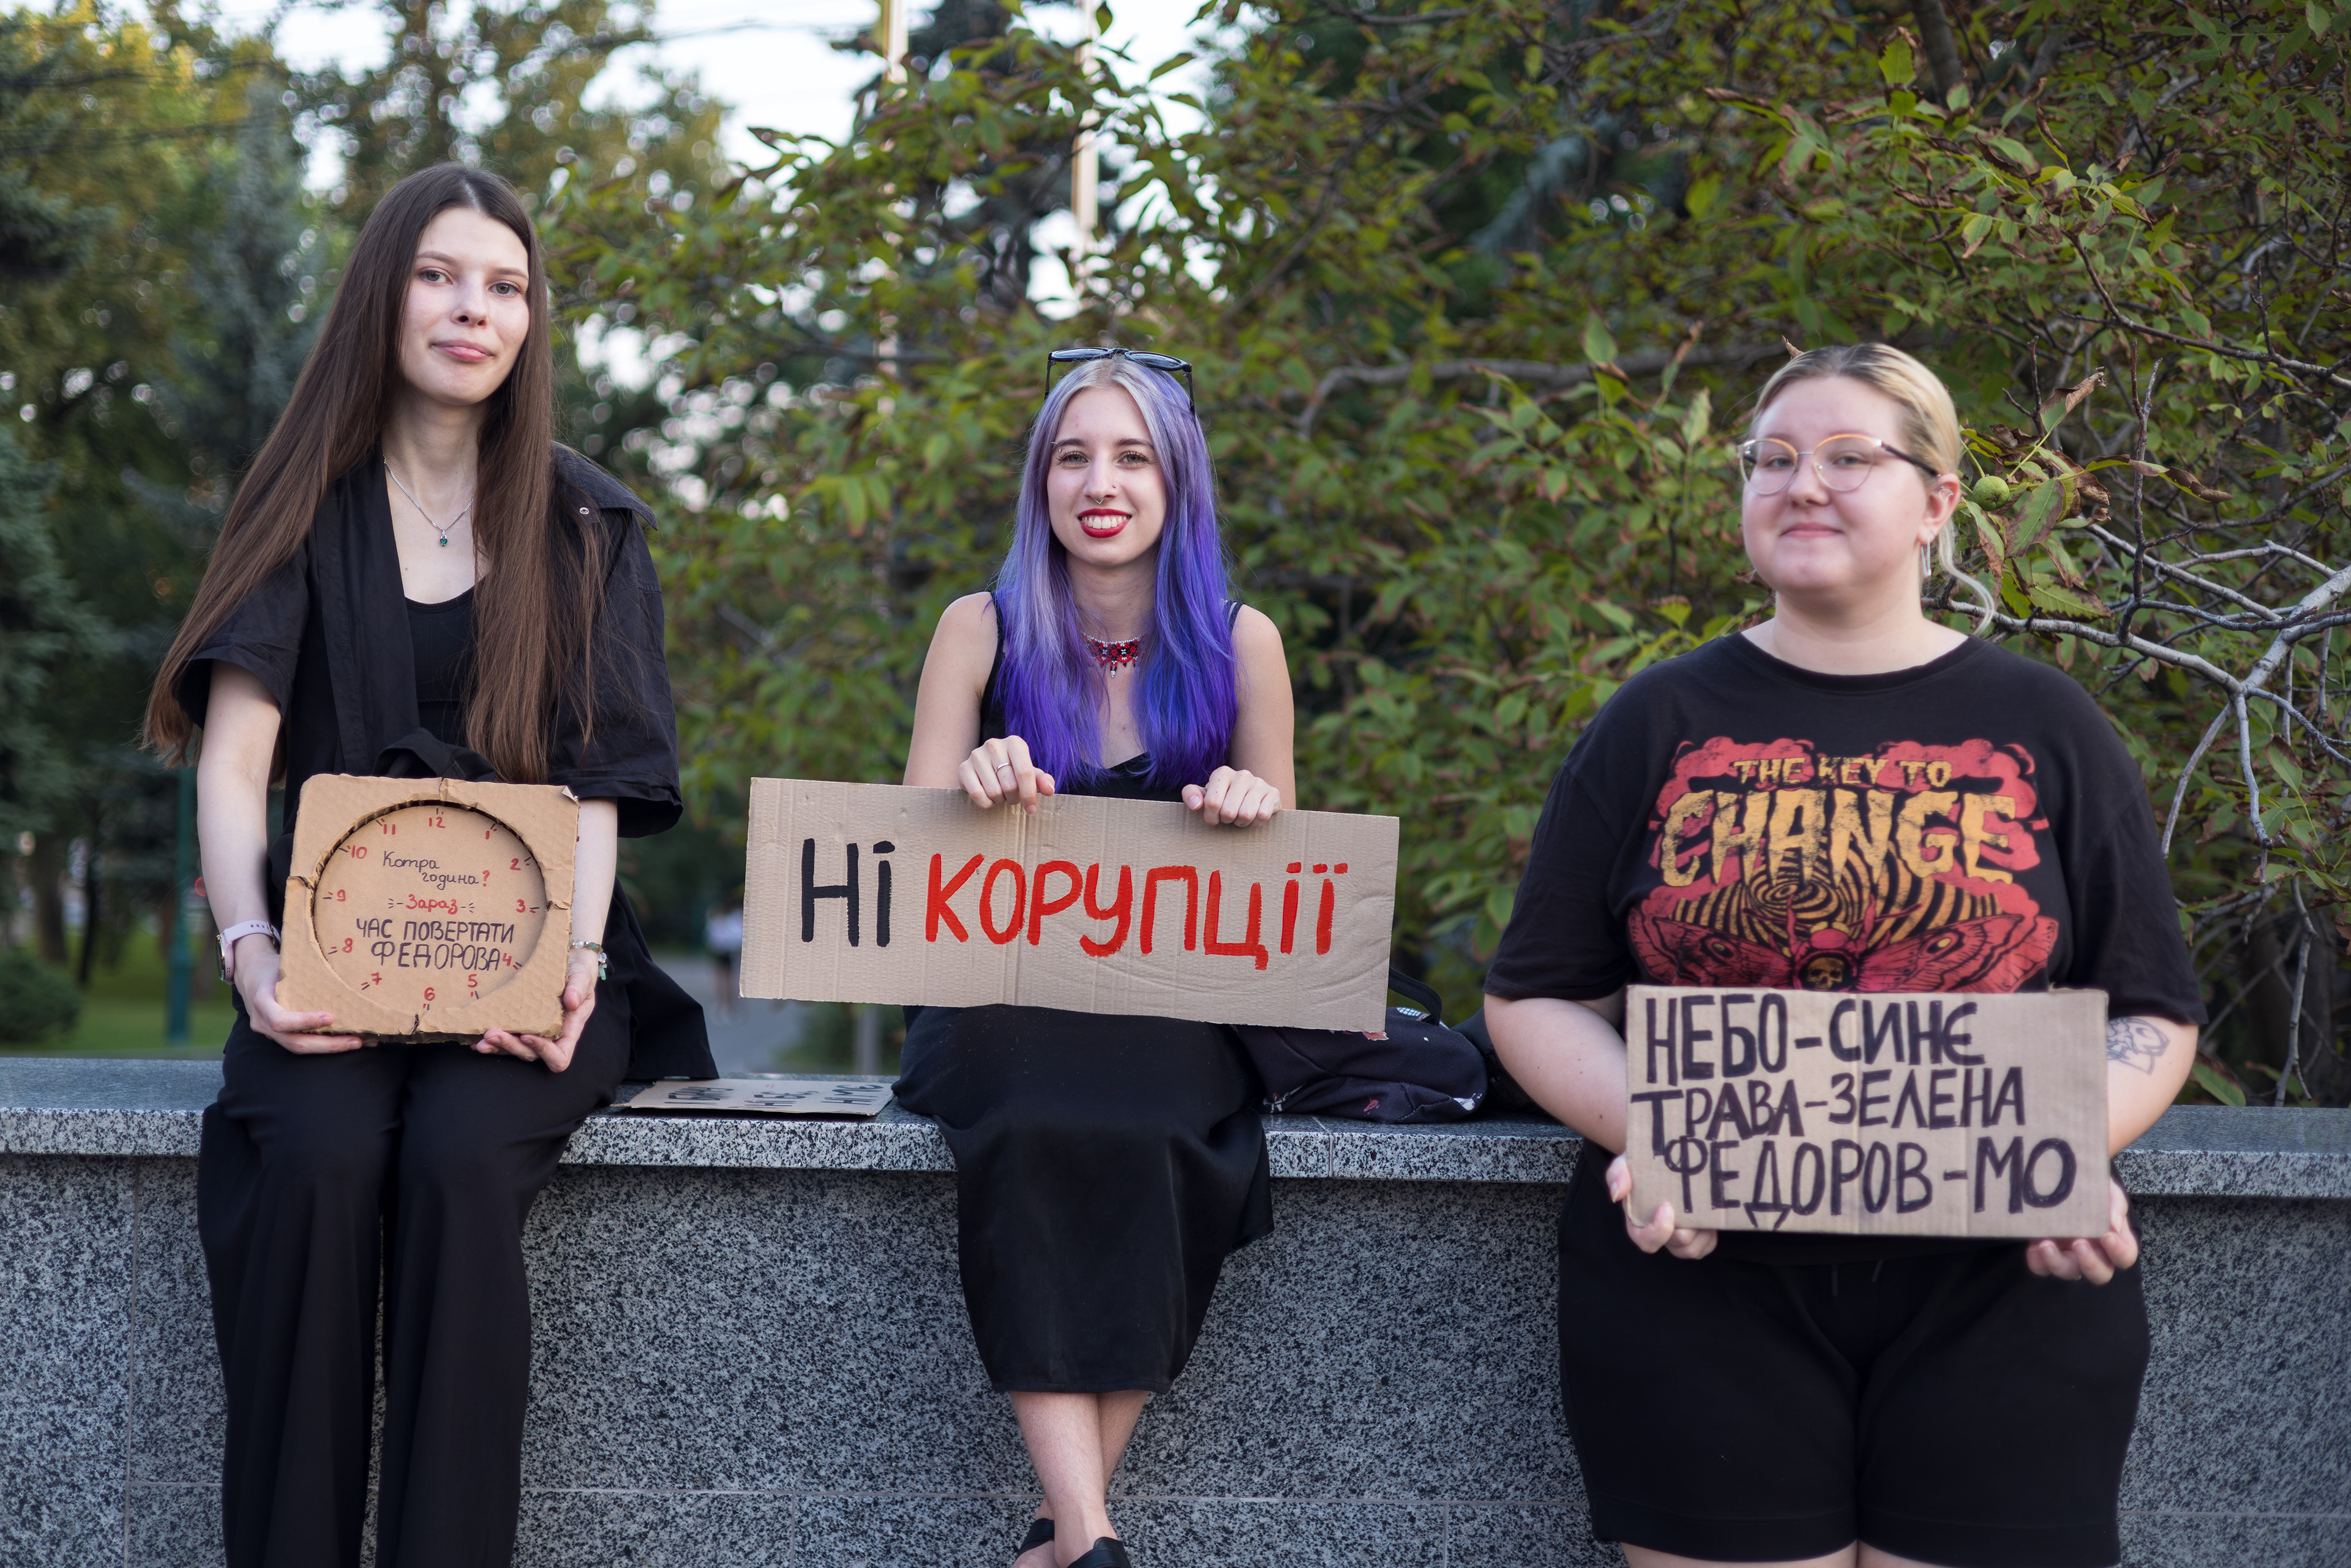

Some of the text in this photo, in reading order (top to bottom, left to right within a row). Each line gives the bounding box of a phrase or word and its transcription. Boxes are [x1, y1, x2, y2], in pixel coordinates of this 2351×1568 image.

[1734, 756, 1953, 788] THE KEY TO
[383, 823, 396, 835] 11
[428, 816, 446, 829] 12
[1660, 787, 2017, 887] CHANGE
[350, 845, 367, 860] 10
[382, 850, 440, 872] Котра
[509, 858, 521, 871] 2
[336, 889, 346, 902] 9
[515, 899, 526, 912] 3
[356, 918, 515, 944] ЧАС ПОВЕРТАТИ
[342, 937, 353, 953] 8
[370, 941, 500, 971] ФЕДОРОВА
[501, 953, 512, 967] 4
[370, 972, 383, 986] 7
[467, 974, 478, 988] 5
[424, 987, 435, 1002] 6
